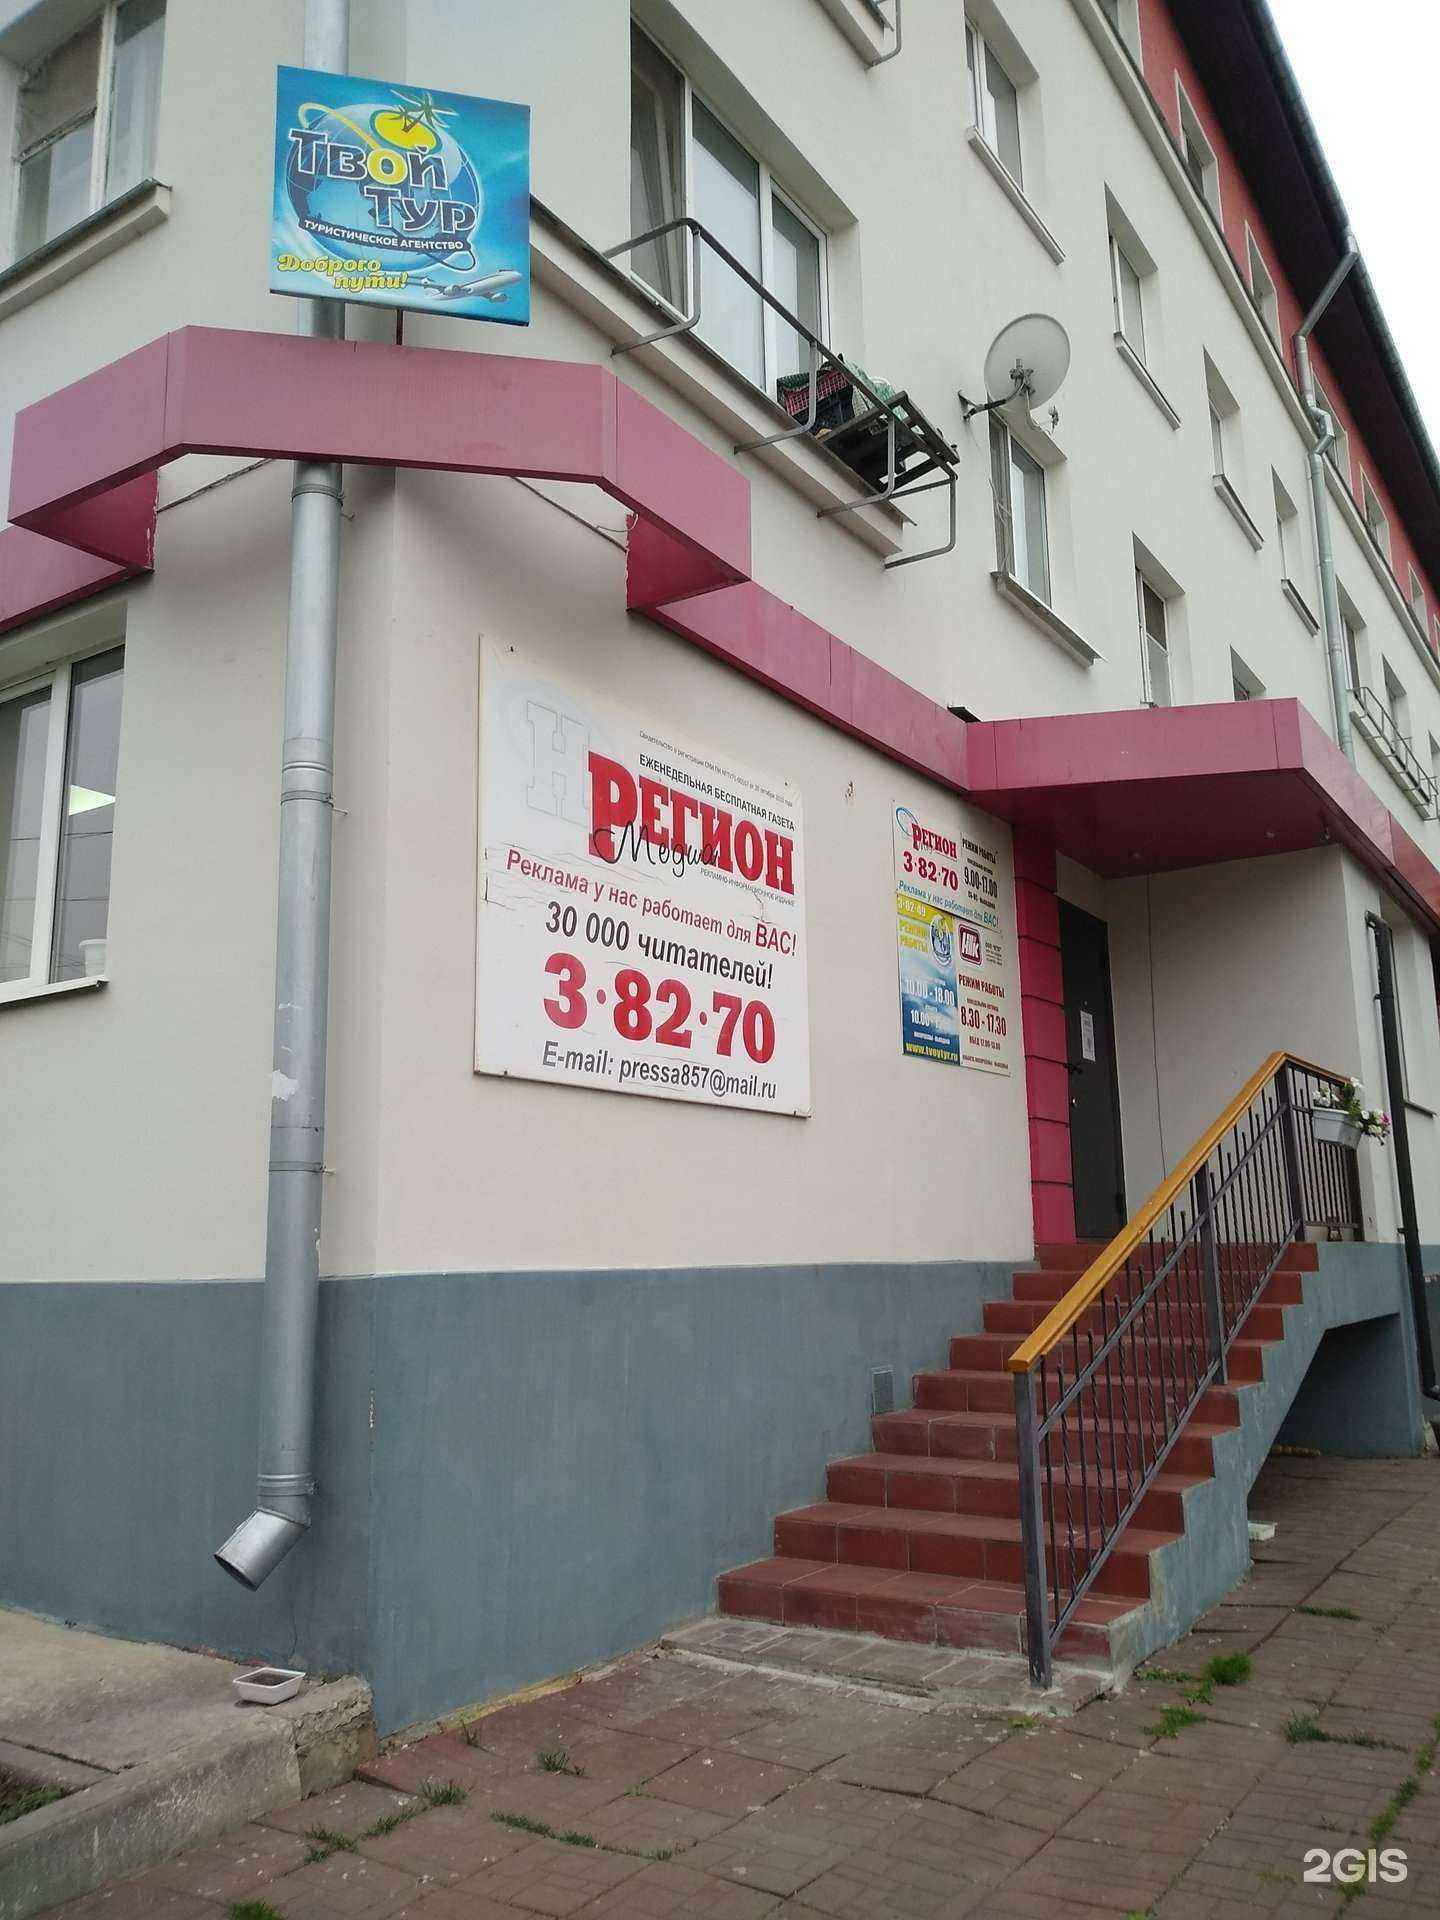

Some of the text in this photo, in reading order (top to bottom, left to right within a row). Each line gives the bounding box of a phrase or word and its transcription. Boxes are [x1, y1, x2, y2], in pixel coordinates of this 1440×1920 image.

[304, 219, 464, 251] ТУРИСТИЧЕСКОЕ АГЕНТСТВО
[277, 254, 382, 276] Доброго
[333, 271, 409, 293] пути!
[640, 753, 713, 796] ЕЖЕНЕДЕЛЬНАЯ
[715, 787, 767, 820] БЕСПЛАТНАЯ
[768, 811, 795, 832] ГАЗЕТА
[506, 849, 797, 957] Реклама у нас работает для ВАС!
[899, 880, 927, 898] Реклама
[932, 894, 943, 904] нас
[546, 901, 773, 990] 30 000 читателей!
[959, 974, 980, 990] РЕЖИМ
[980, 980, 1005, 998] РАБОТЫ
[960, 1006, 980, 1029] 8.30
[986, 1013, 1007, 1037] 17.30
[542, 1040, 777, 1099] E-mail: pressa857@mail.ru
